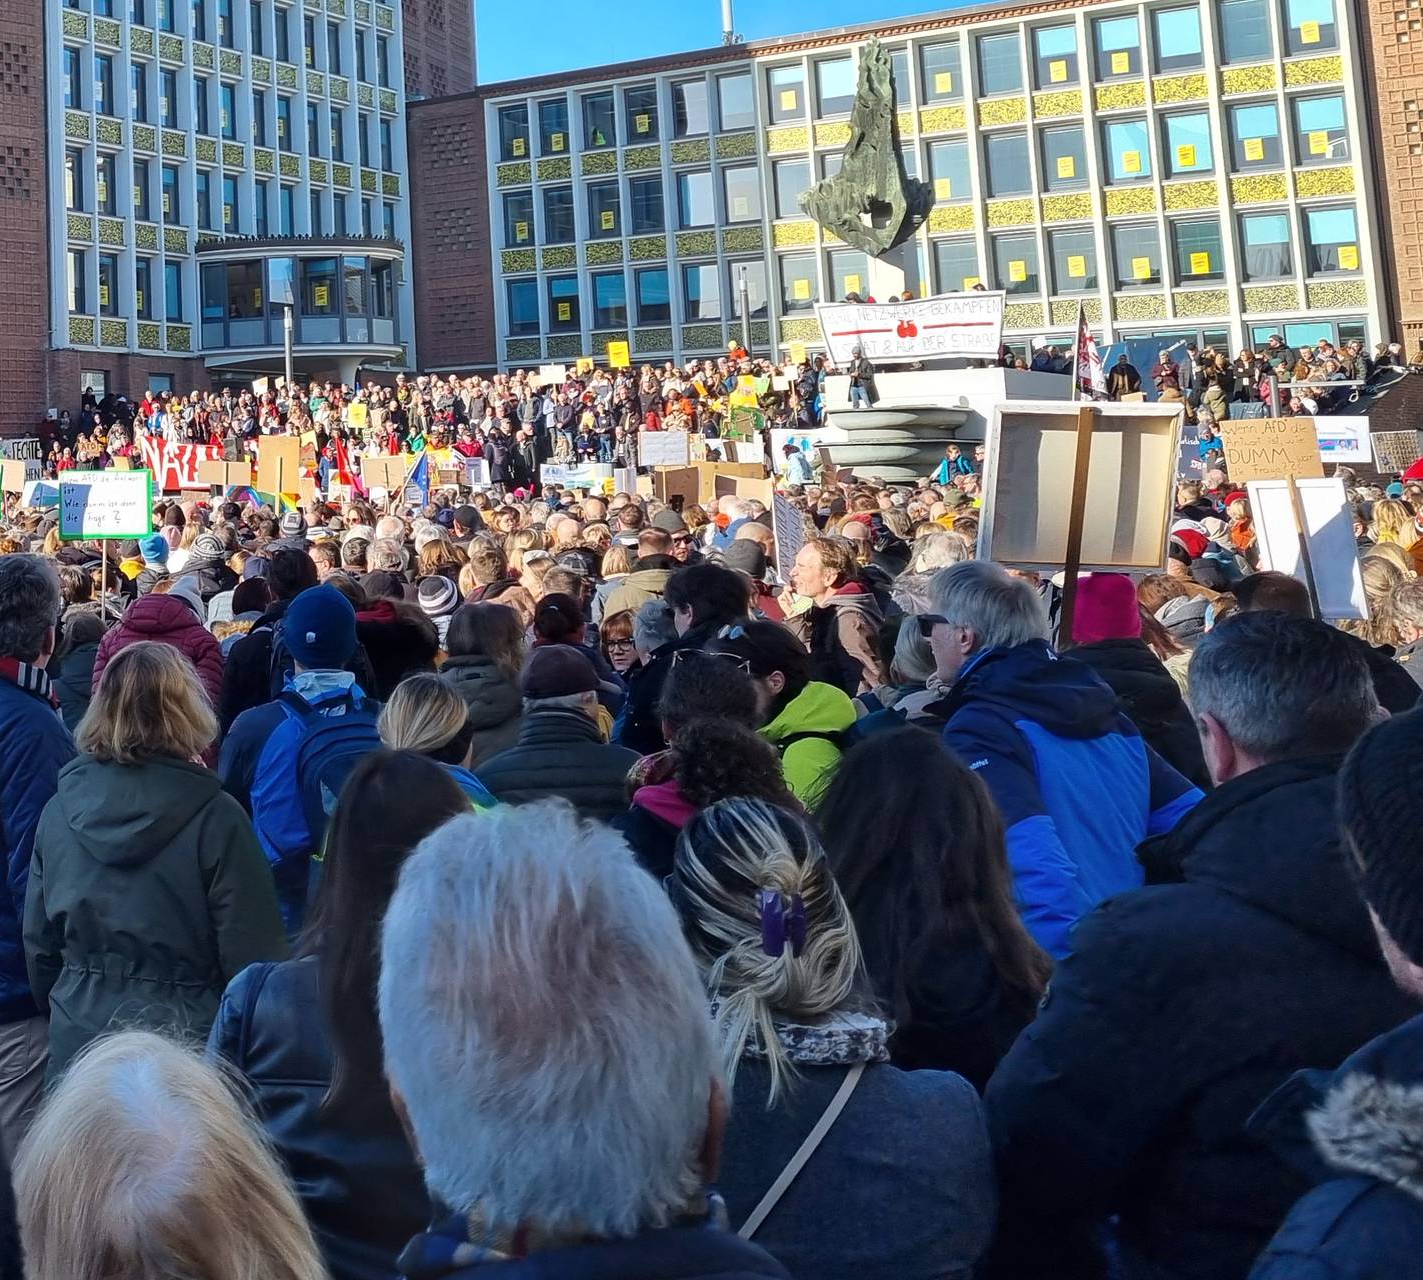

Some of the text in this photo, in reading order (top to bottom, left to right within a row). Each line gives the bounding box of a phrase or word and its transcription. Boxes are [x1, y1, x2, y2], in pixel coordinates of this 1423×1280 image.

[1228, 447, 1295, 465] DUMM
[63, 486, 75, 495] ist
[64, 498, 79, 508] Wie
[65, 513, 78, 523] die
